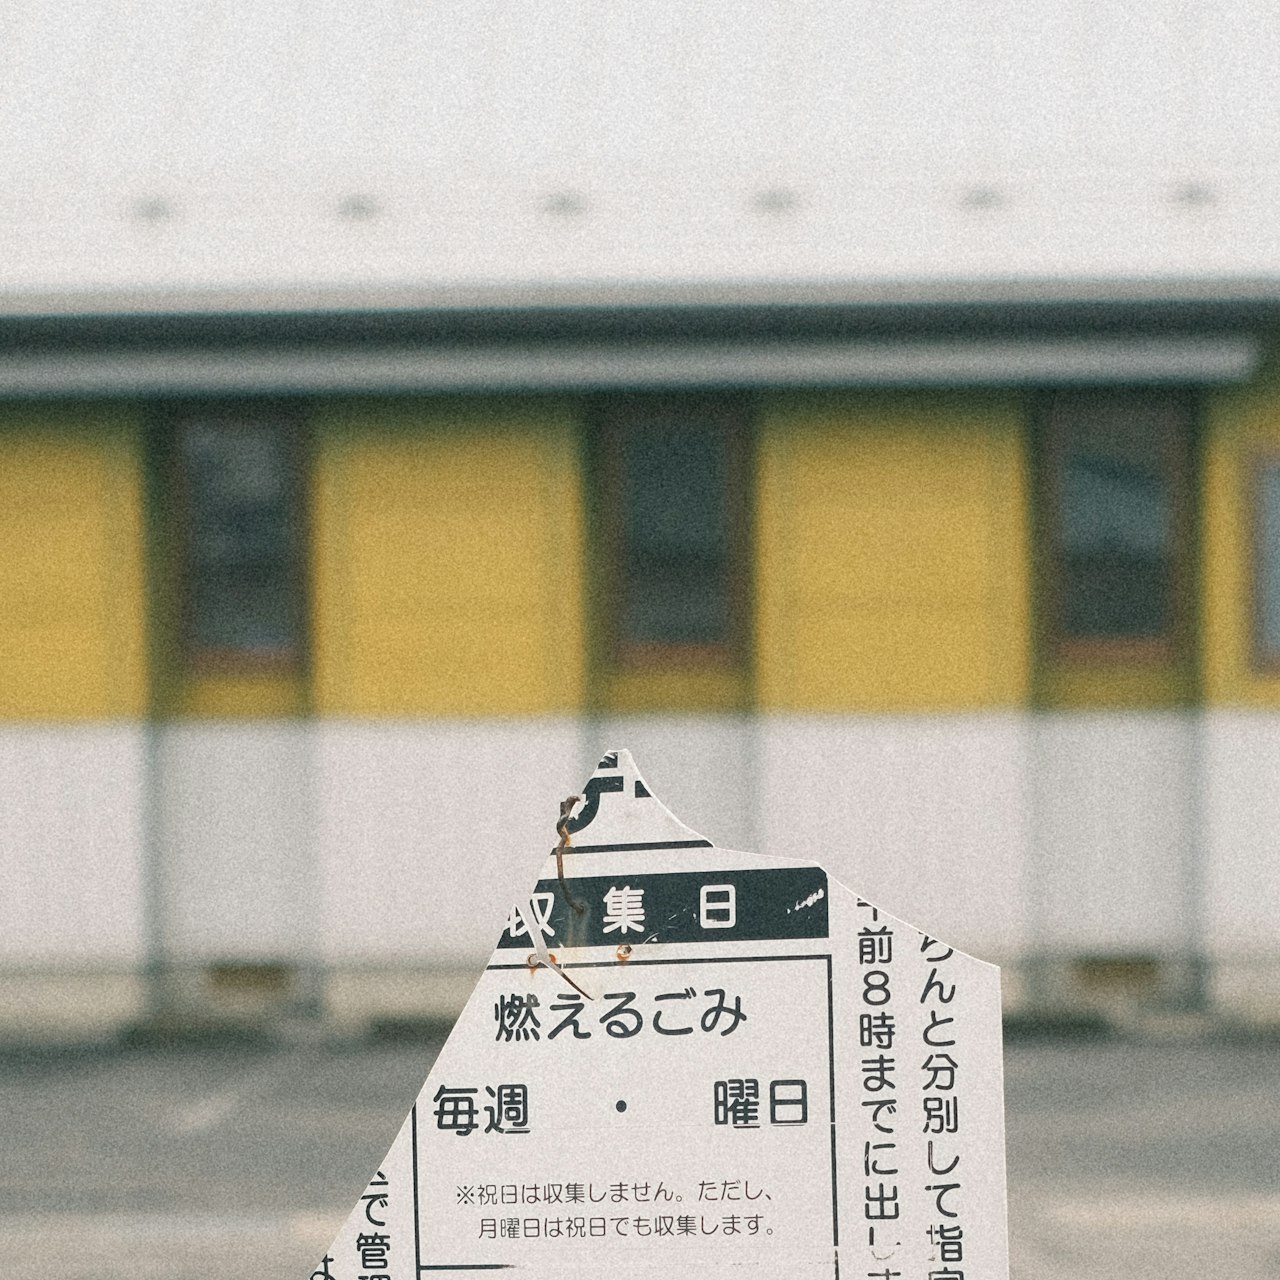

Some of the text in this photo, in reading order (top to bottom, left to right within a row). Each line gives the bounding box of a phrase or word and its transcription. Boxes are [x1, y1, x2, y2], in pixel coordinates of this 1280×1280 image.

[494, 987, 747, 1042] 燃えるごみ
[433, 1084, 531, 1136] 毎週
[713, 1078, 808, 1128] 曜日
[456, 1180, 773, 1206] ※祝日は収集しません。ただし、
[478, 1214, 774, 1240] 月曜日は祝日でも収集します。
